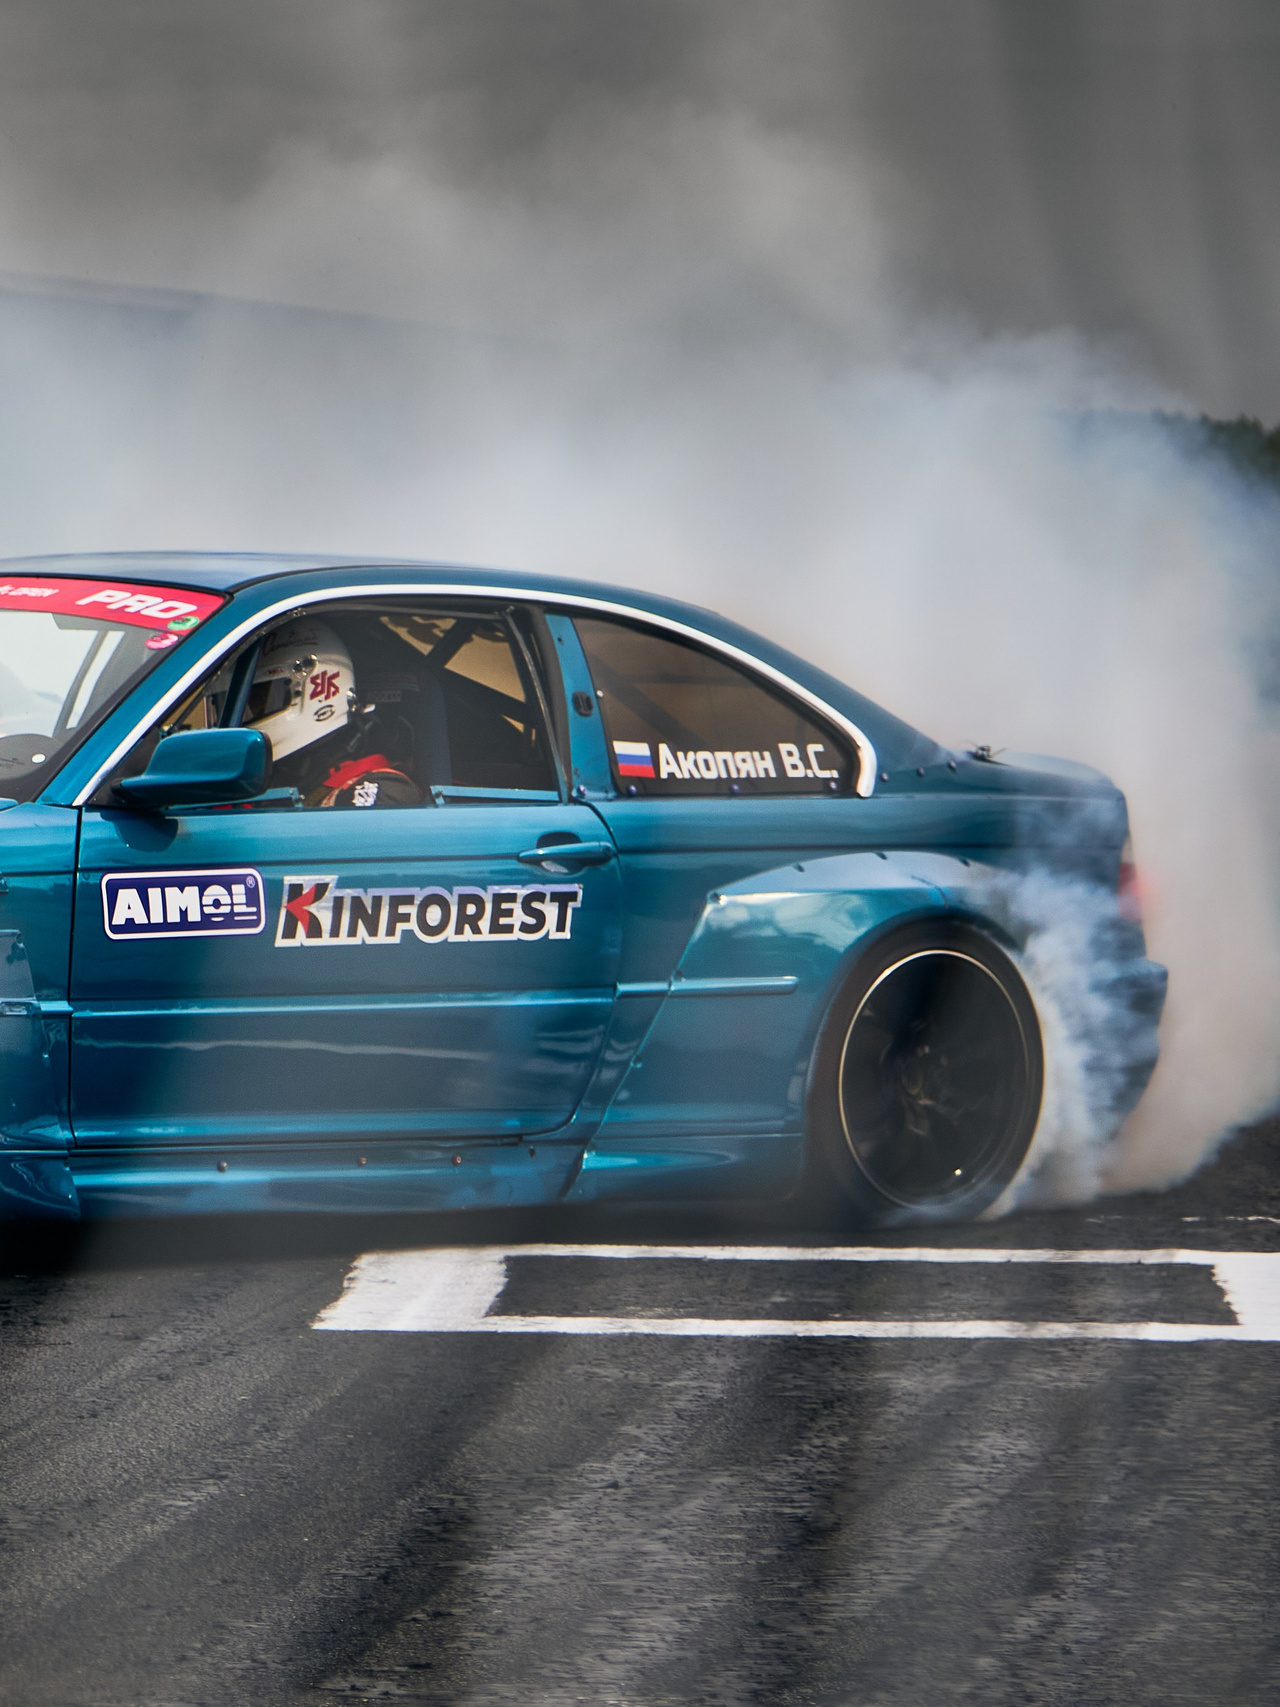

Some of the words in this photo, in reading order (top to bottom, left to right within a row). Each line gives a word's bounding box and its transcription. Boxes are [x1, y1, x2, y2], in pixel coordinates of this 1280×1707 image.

[75, 590, 198, 618] PRO
[658, 743, 777, 779] Акопян
[111, 884, 258, 925] AIMOL
[278, 880, 580, 942] KINFOREST
